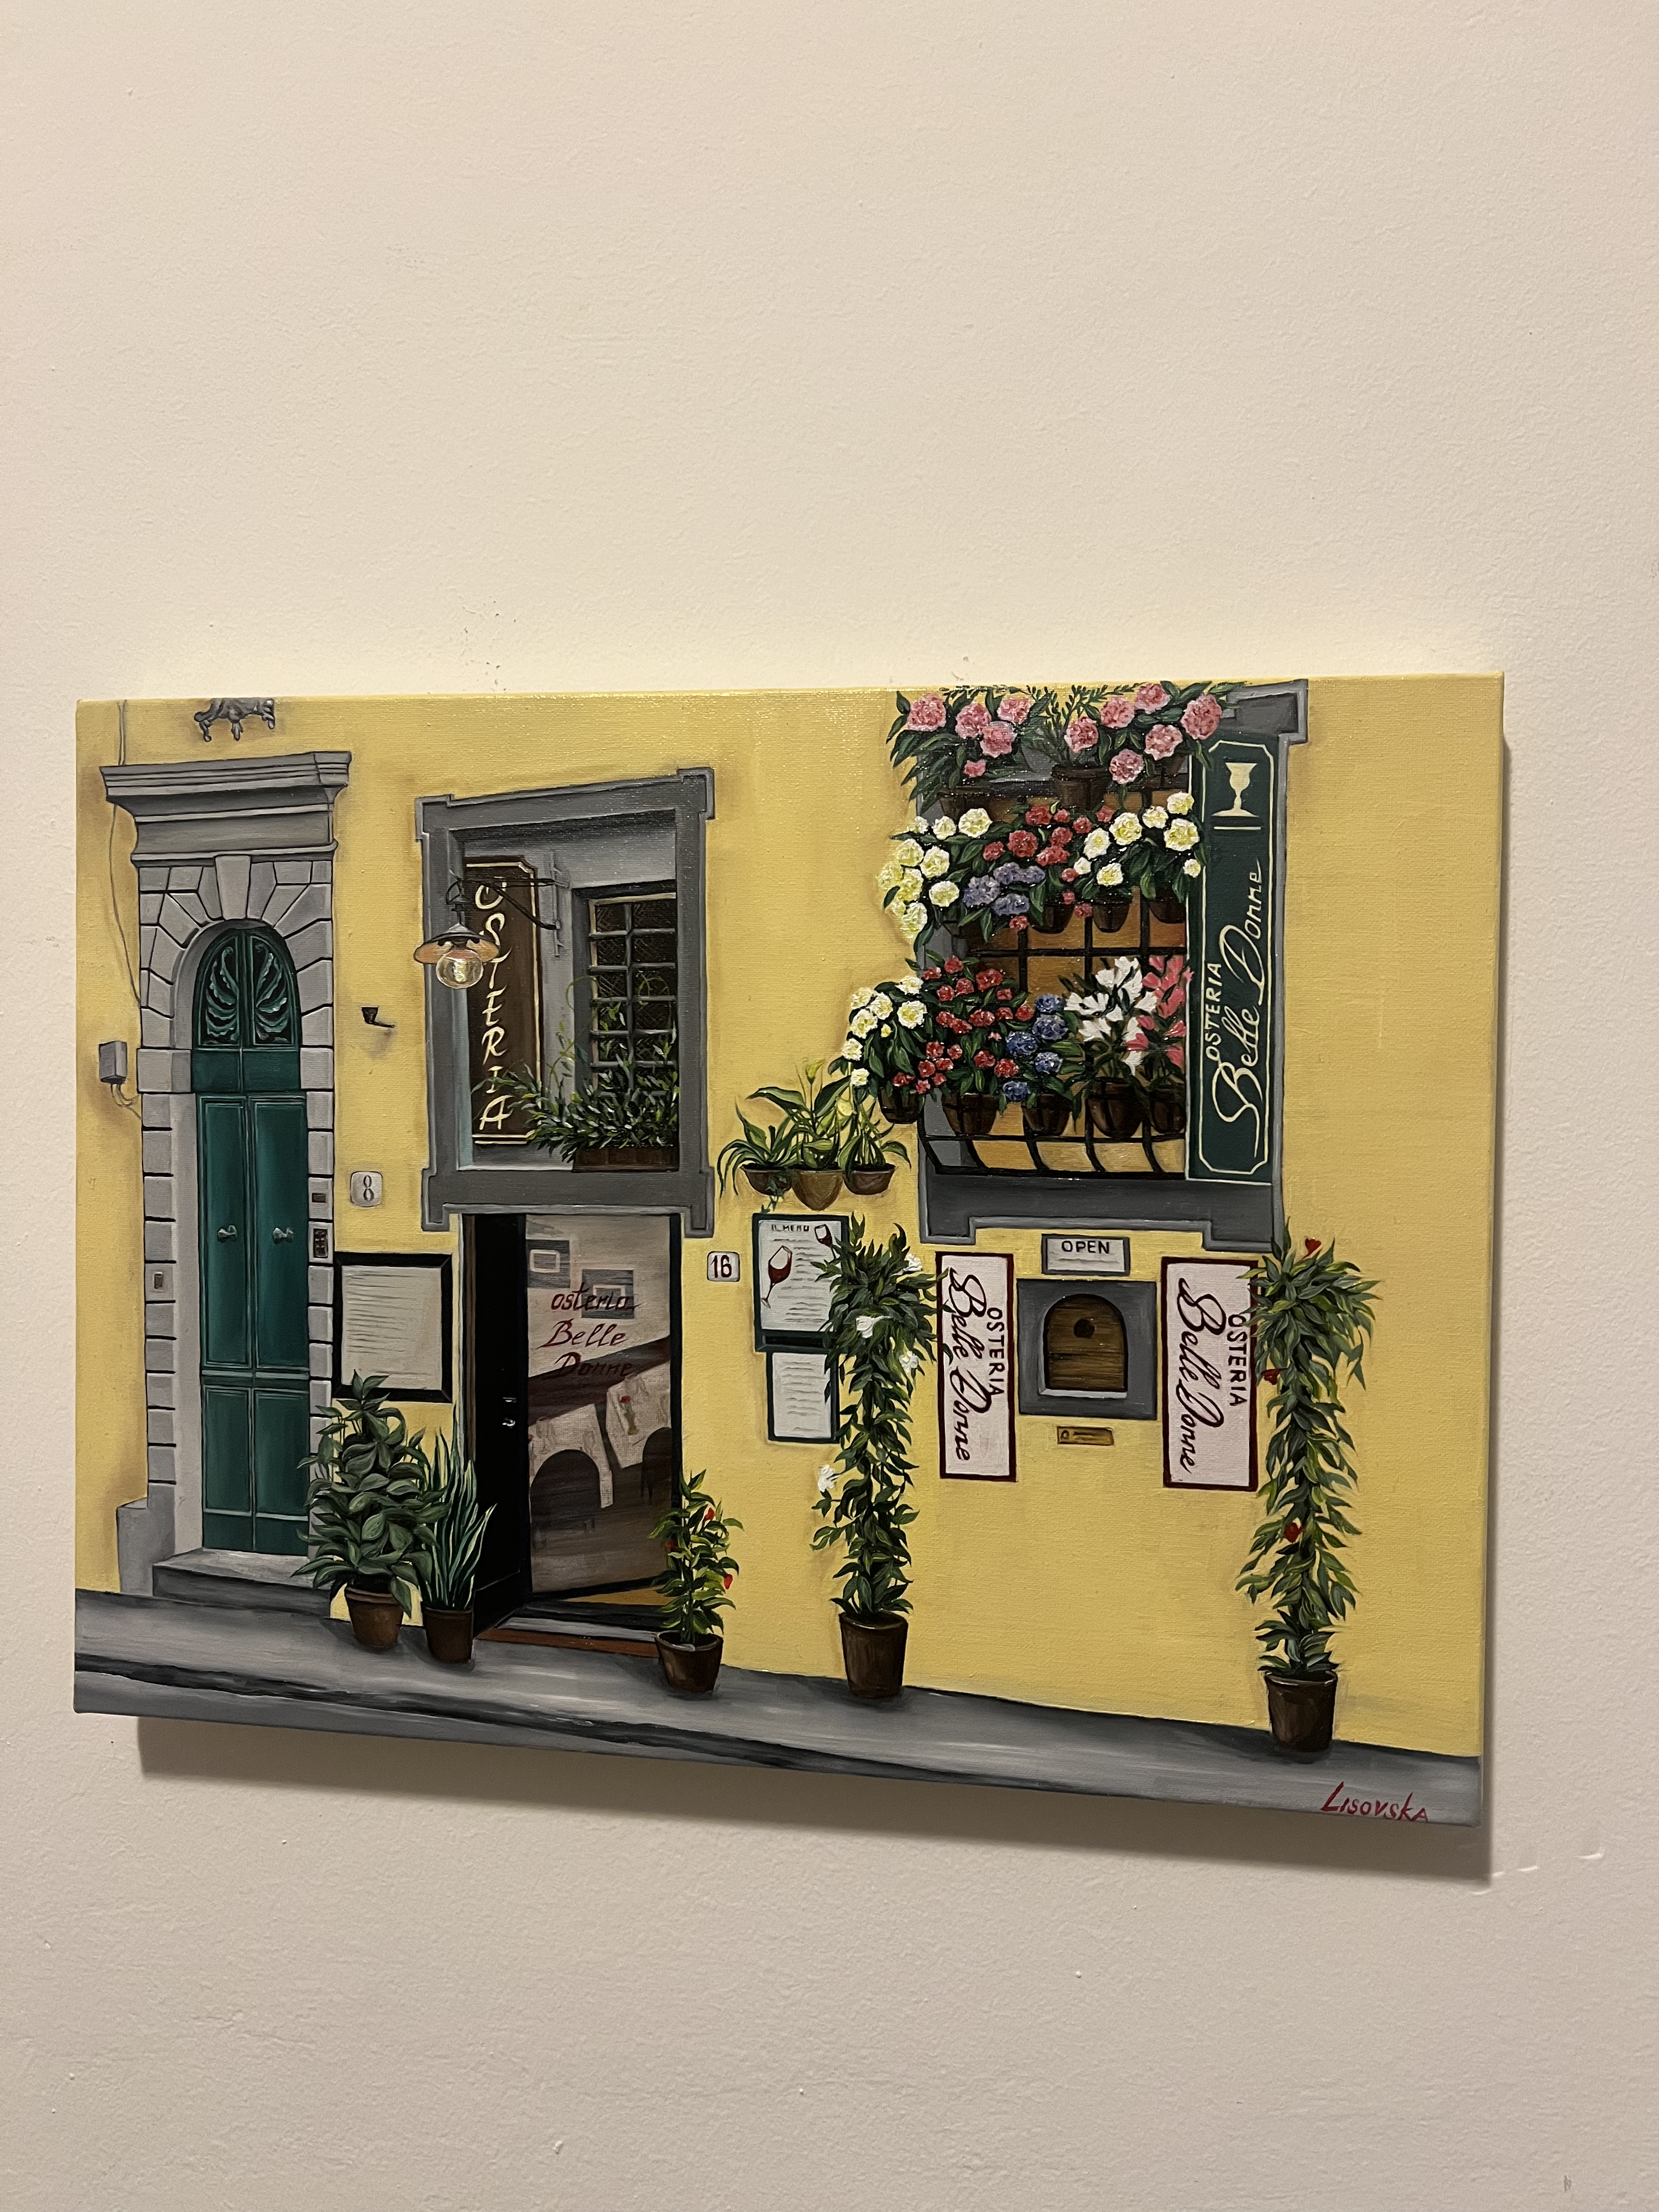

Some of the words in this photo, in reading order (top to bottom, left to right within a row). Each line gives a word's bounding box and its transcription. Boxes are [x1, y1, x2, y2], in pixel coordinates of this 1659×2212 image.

[1218, 859, 1265, 1006] Donne
[475, 876, 514, 1131] OSTERIA
[1206, 962, 1222, 1062] OSTERIA
[1211, 1005, 1263, 1158] Belle
[363, 1175, 375, 1202] 8
[710, 1254, 732, 1278] 16
[1061, 1240, 1110, 1254] OPEN
[534, 1318, 629, 1351] Belle
[948, 1267, 988, 1361] Belle
[986, 1307, 1005, 1396] OSTERIA
[1176, 1277, 1227, 1390] Belle
[1226, 1313, 1248, 1407] OSTERIA
[543, 1351, 634, 1380] Donne
[949, 1365, 992, 1461] Donne
[1176, 1378, 1224, 1474] Donne
